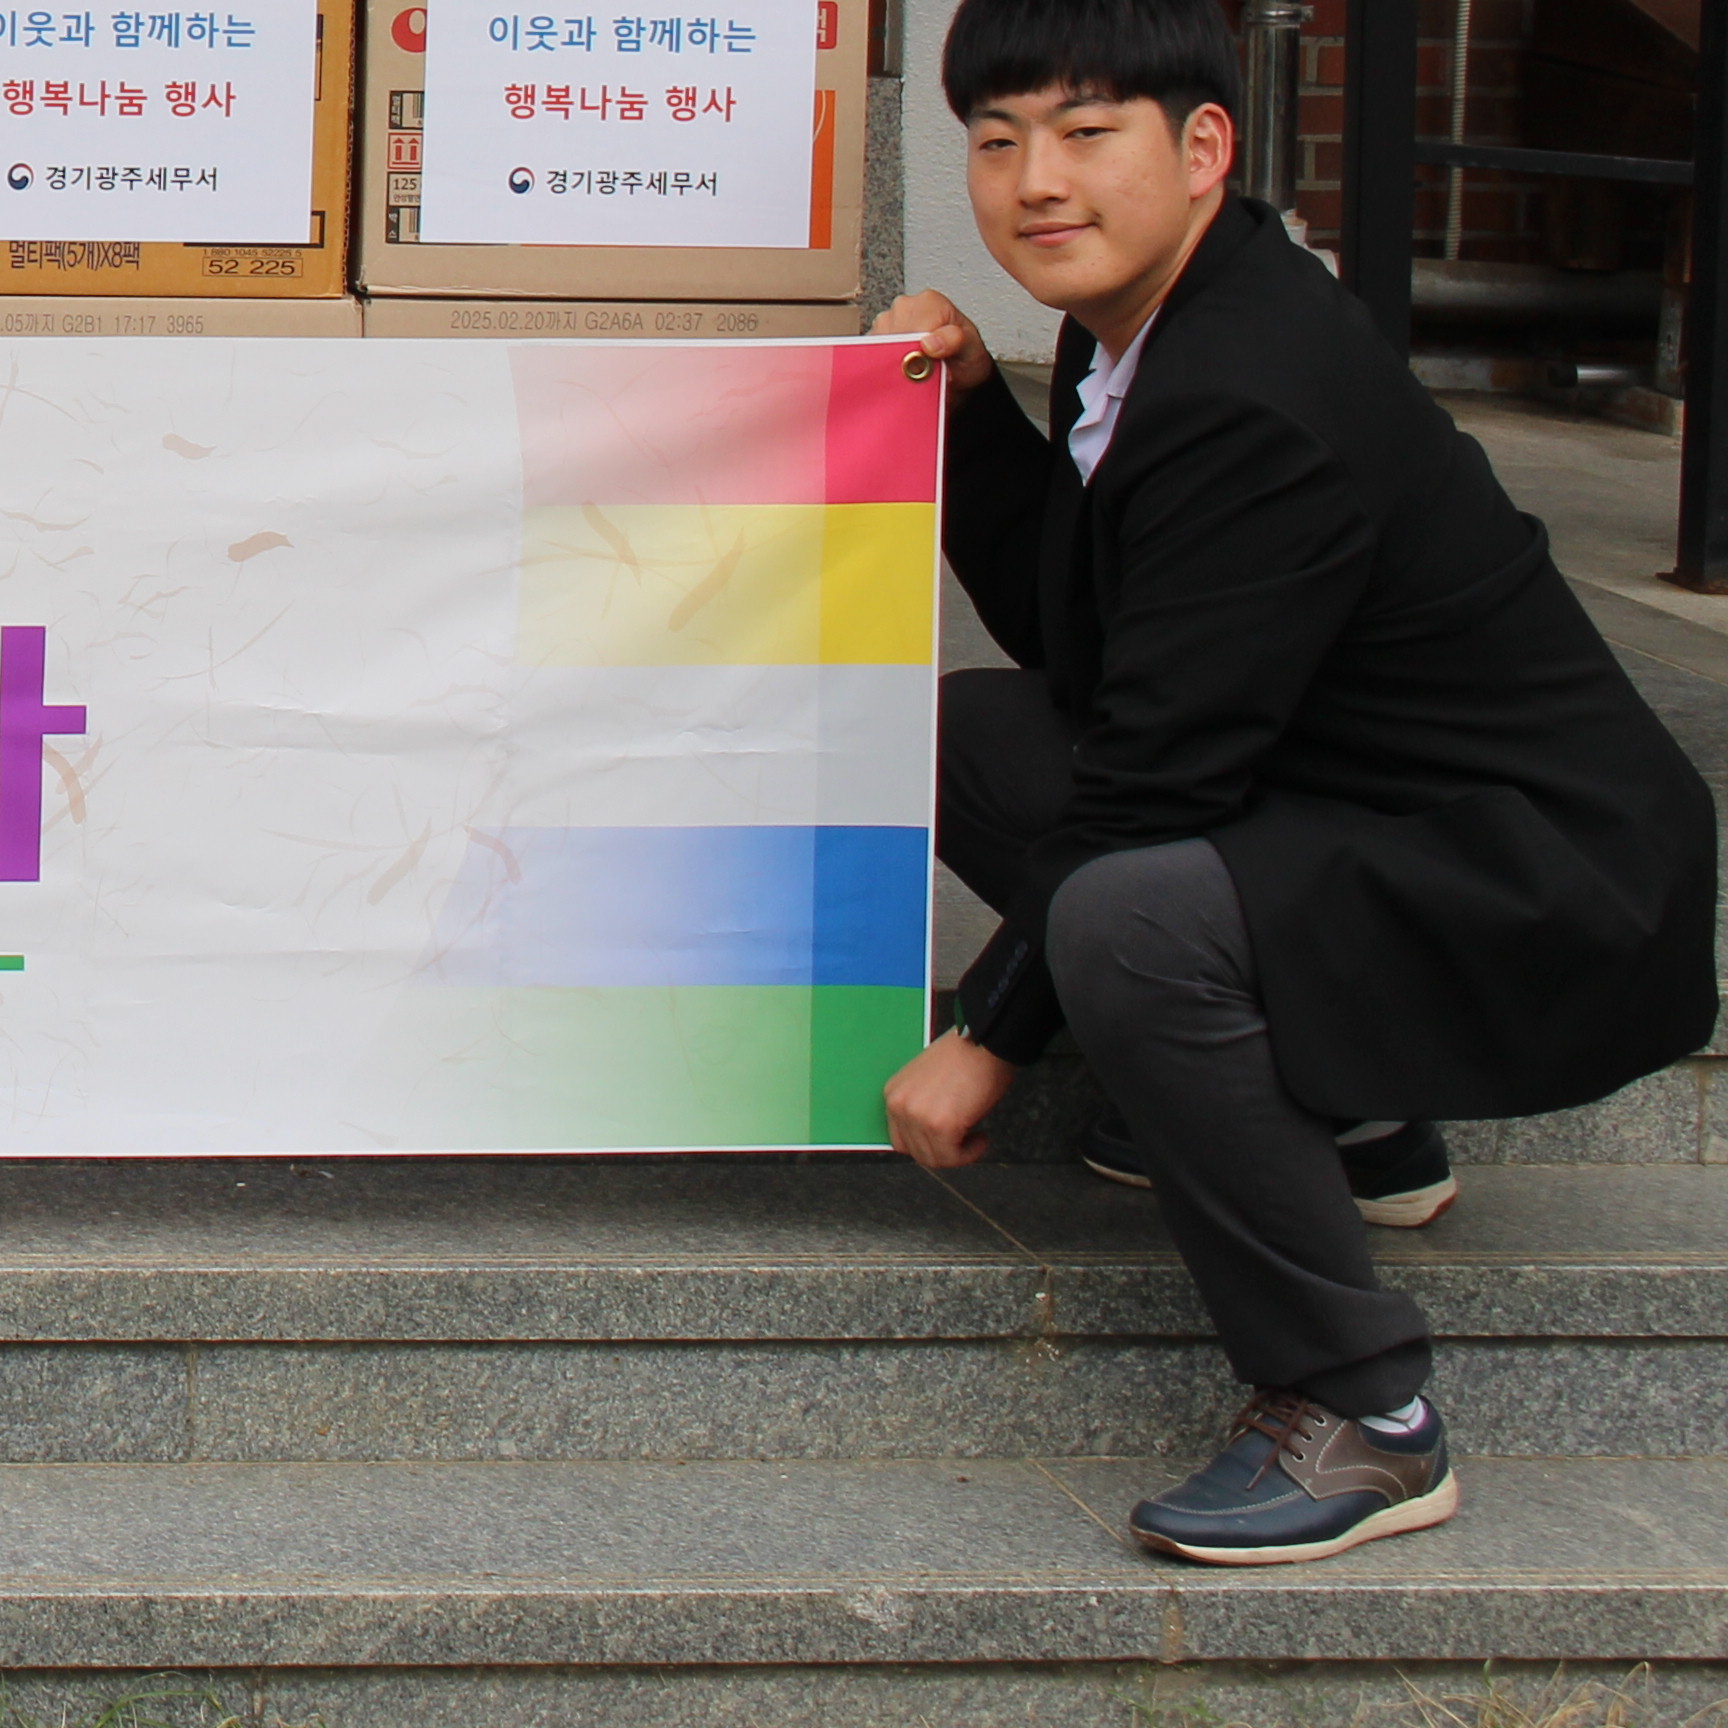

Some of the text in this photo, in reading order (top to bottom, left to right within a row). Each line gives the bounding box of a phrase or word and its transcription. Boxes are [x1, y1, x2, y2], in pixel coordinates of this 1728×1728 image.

[110, 10, 257, 50] 함께하는
[488, 14, 758, 55] 이웃과 함께하는
[1, 78, 238, 119] 행복나눔 행사
[503, 83, 737, 124] 행복나눔 행사
[44, 164, 219, 192] 경기광주세무서
[392, 177, 418, 191] 125
[545, 168, 718, 197] 경기광주세무서
[62, 312, 103, 334] G2B1
[114, 313, 156, 334] 17:17
[166, 313, 204, 335] 3965
[450, 310, 578, 331] 2025.02.20까지
[584, 311, 644, 332] G2A6A
[655, 312, 703, 332] 02:37
